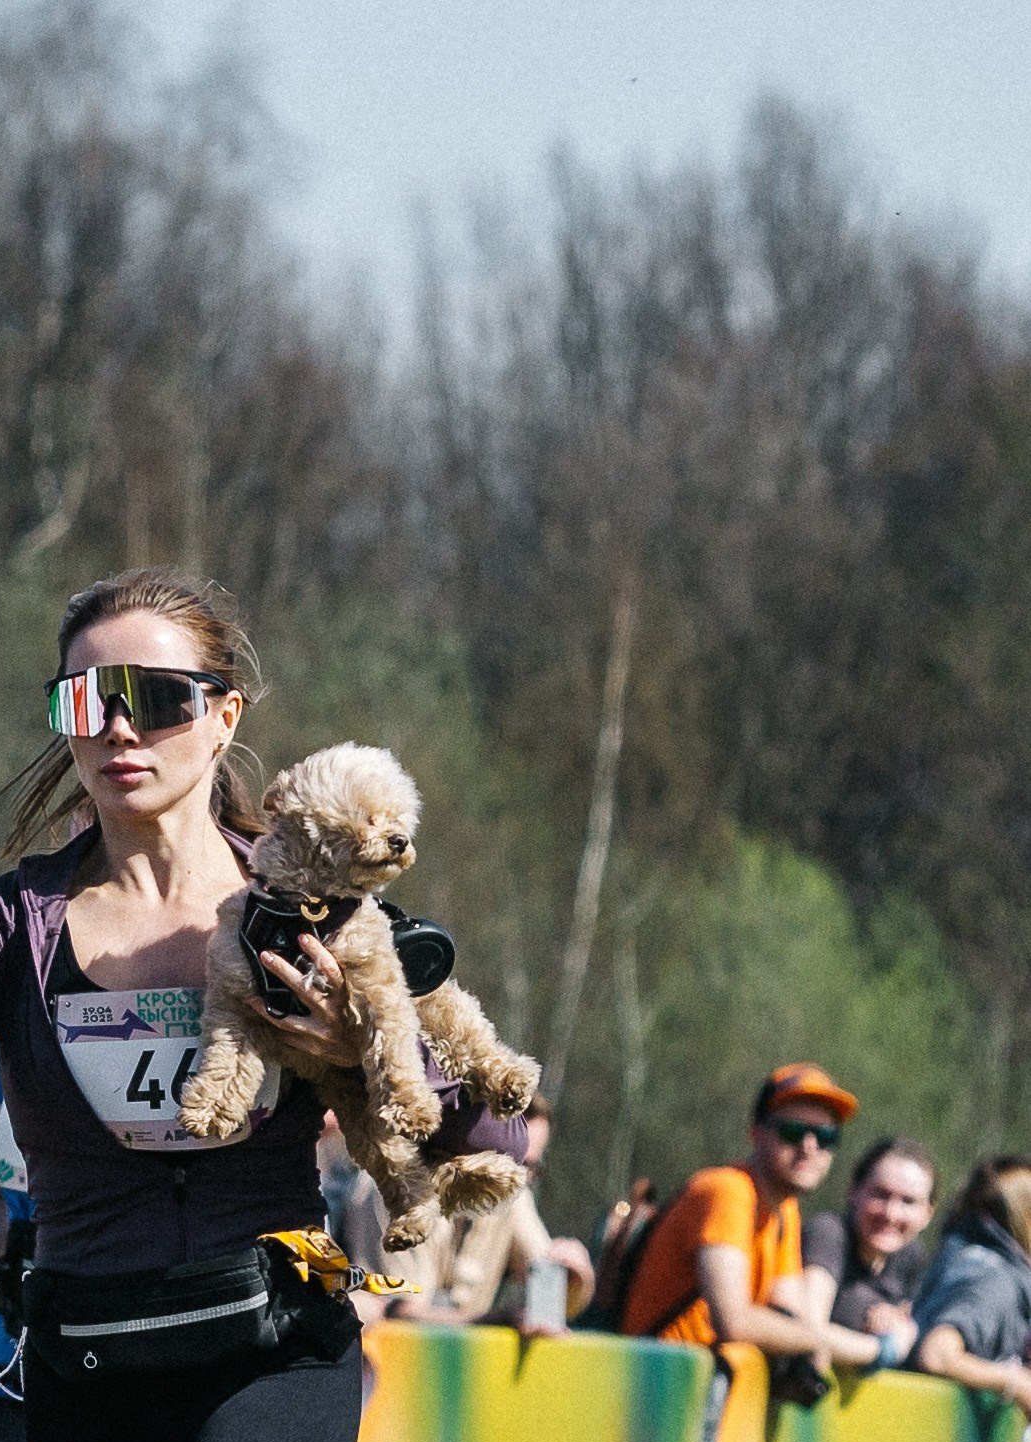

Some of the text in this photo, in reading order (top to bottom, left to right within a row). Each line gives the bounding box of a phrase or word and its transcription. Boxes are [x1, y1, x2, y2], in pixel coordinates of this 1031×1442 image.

[82, 1006, 112, 1016] 19.04
[137, 1006, 202, 1022] БЫСТРЫ
[82, 1014, 114, 1023] 2025
